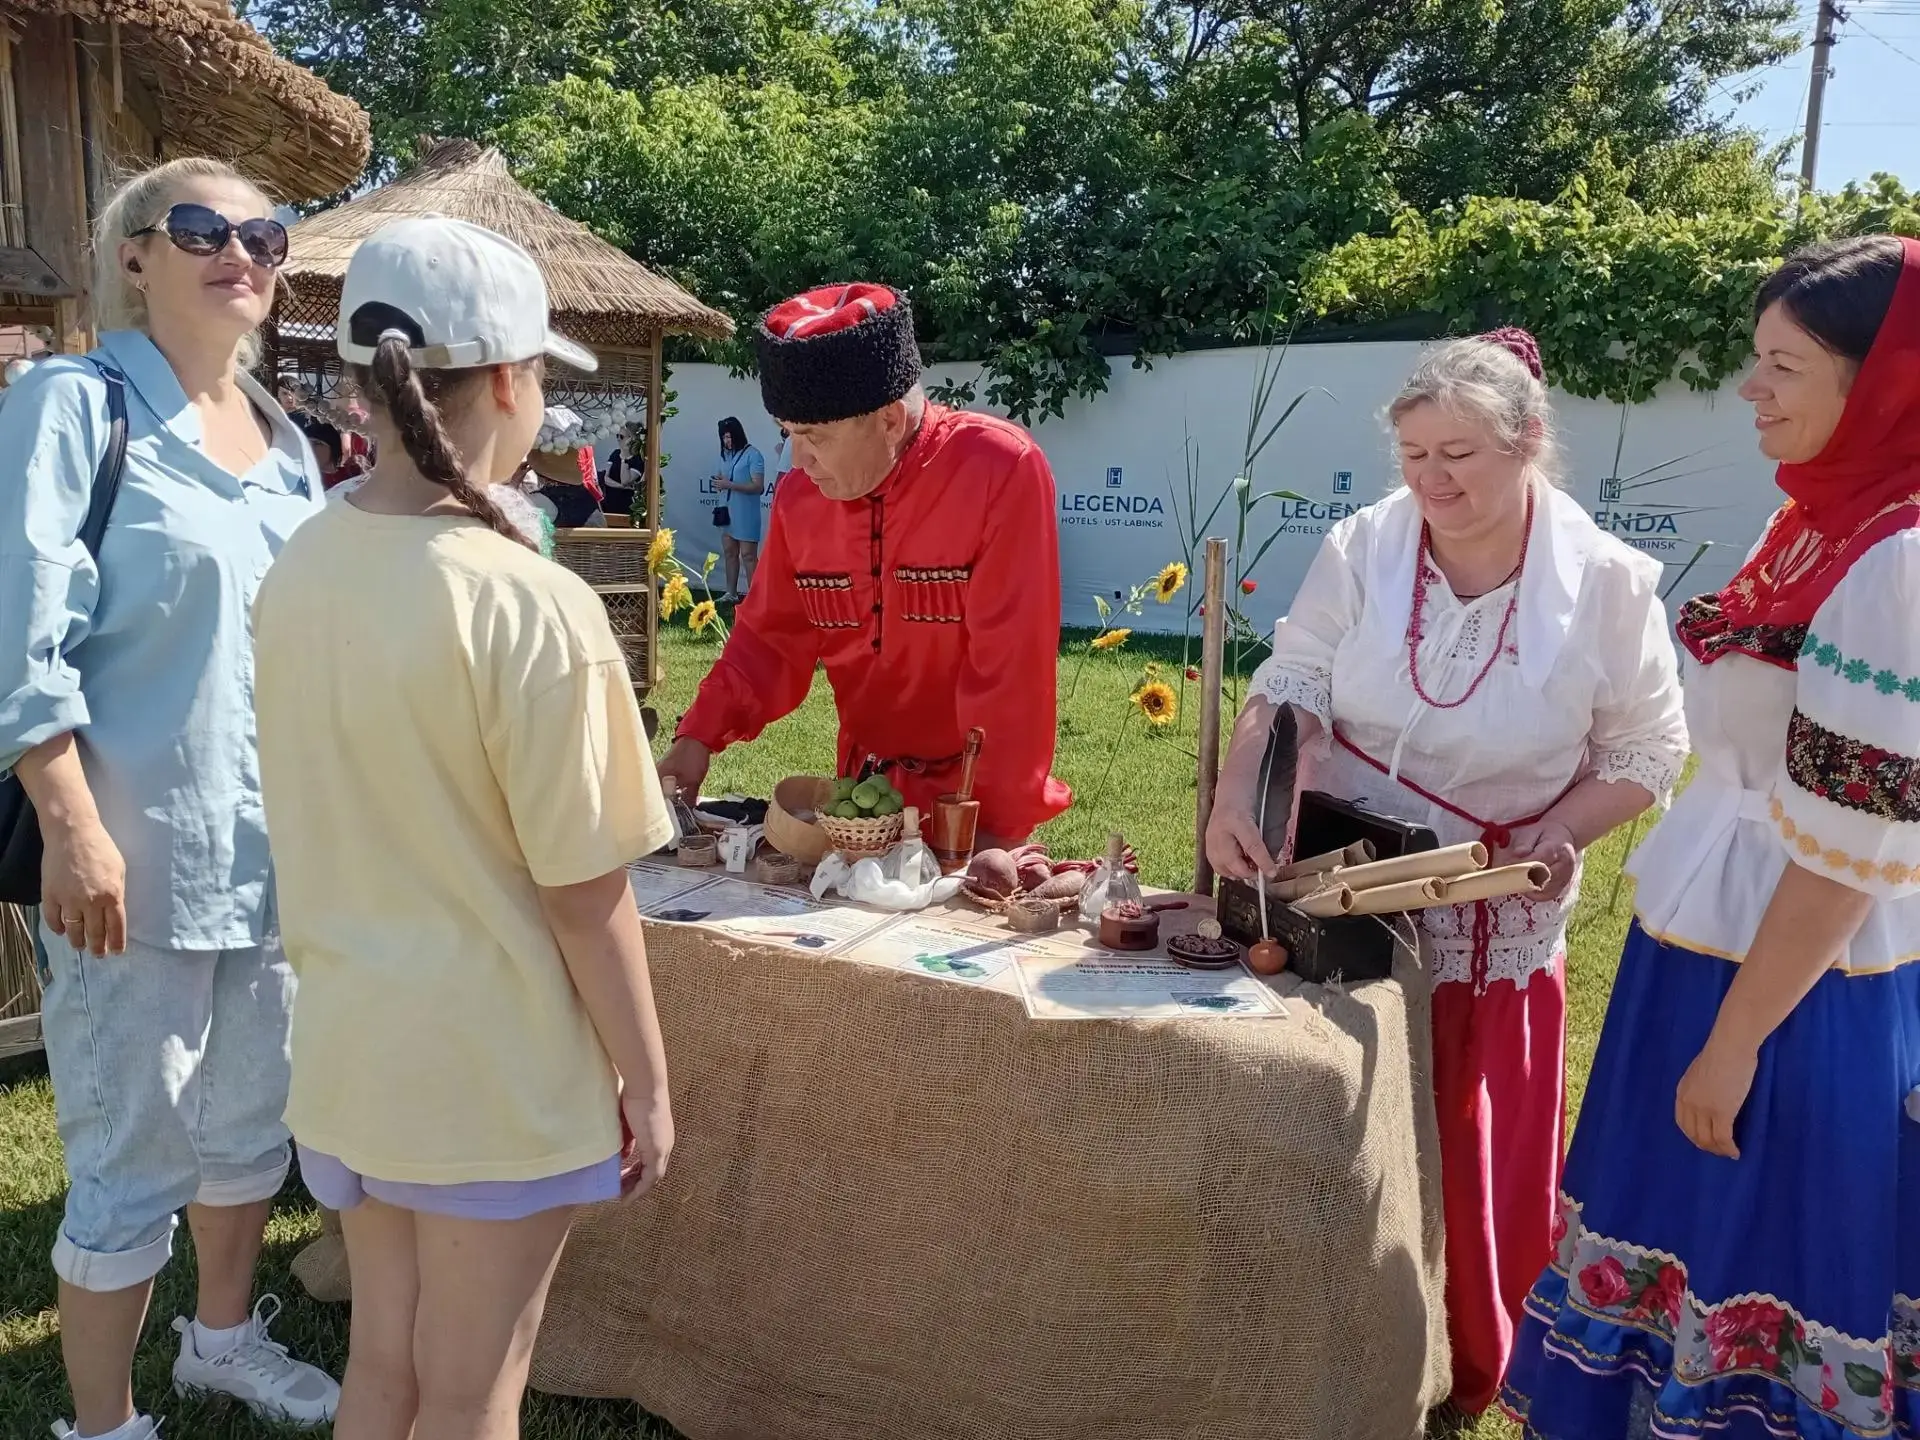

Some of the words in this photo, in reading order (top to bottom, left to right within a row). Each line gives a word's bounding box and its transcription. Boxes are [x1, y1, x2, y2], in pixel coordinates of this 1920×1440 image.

[1061, 494, 1164, 514] LEGENDA
[1281, 501, 1376, 520] LEGEN
[1061, 516, 1098, 525] HOTELS
[1104, 518, 1163, 528] UST-LABINSK
[1281, 525, 1323, 535] HOTELS
[1595, 511, 1677, 533] ENDA
